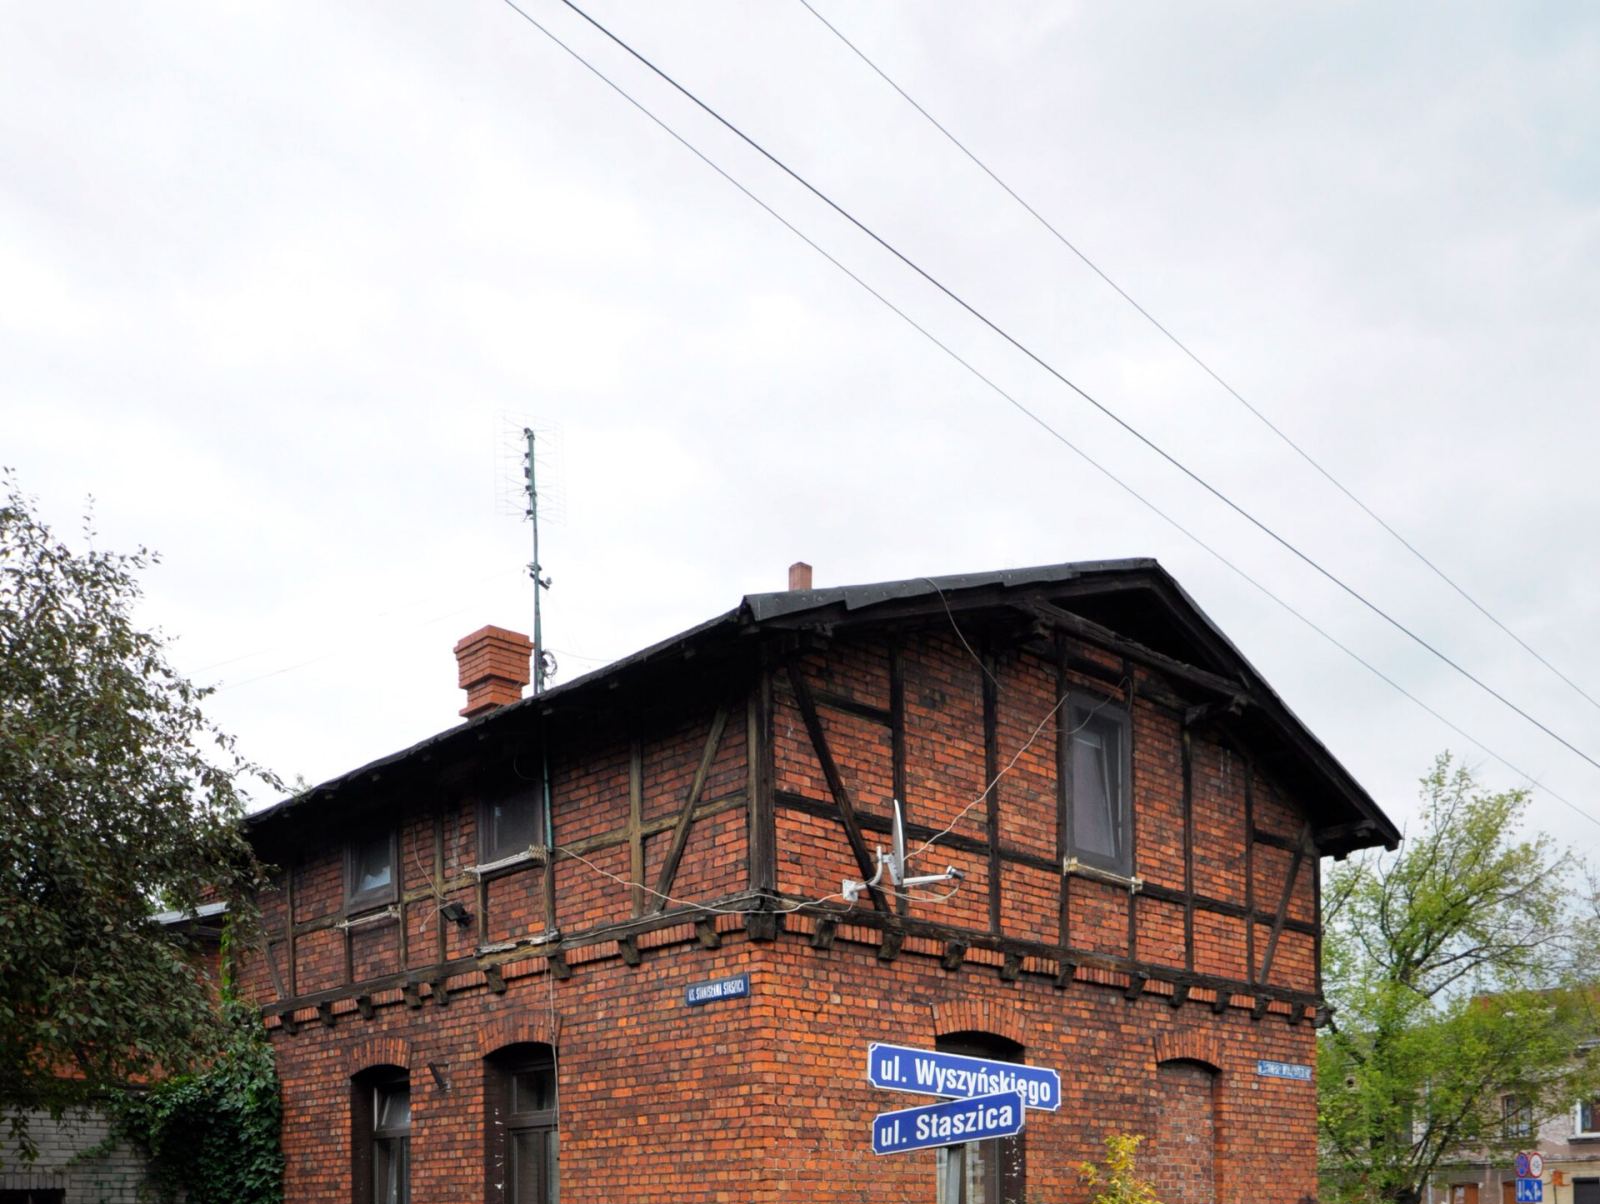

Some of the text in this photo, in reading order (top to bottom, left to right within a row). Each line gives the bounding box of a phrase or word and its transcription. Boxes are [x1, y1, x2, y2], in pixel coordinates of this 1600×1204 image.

[880, 1056, 1051, 1106] ul. Wyszyńskiego
[880, 1104, 1013, 1147] ul. Staszica
